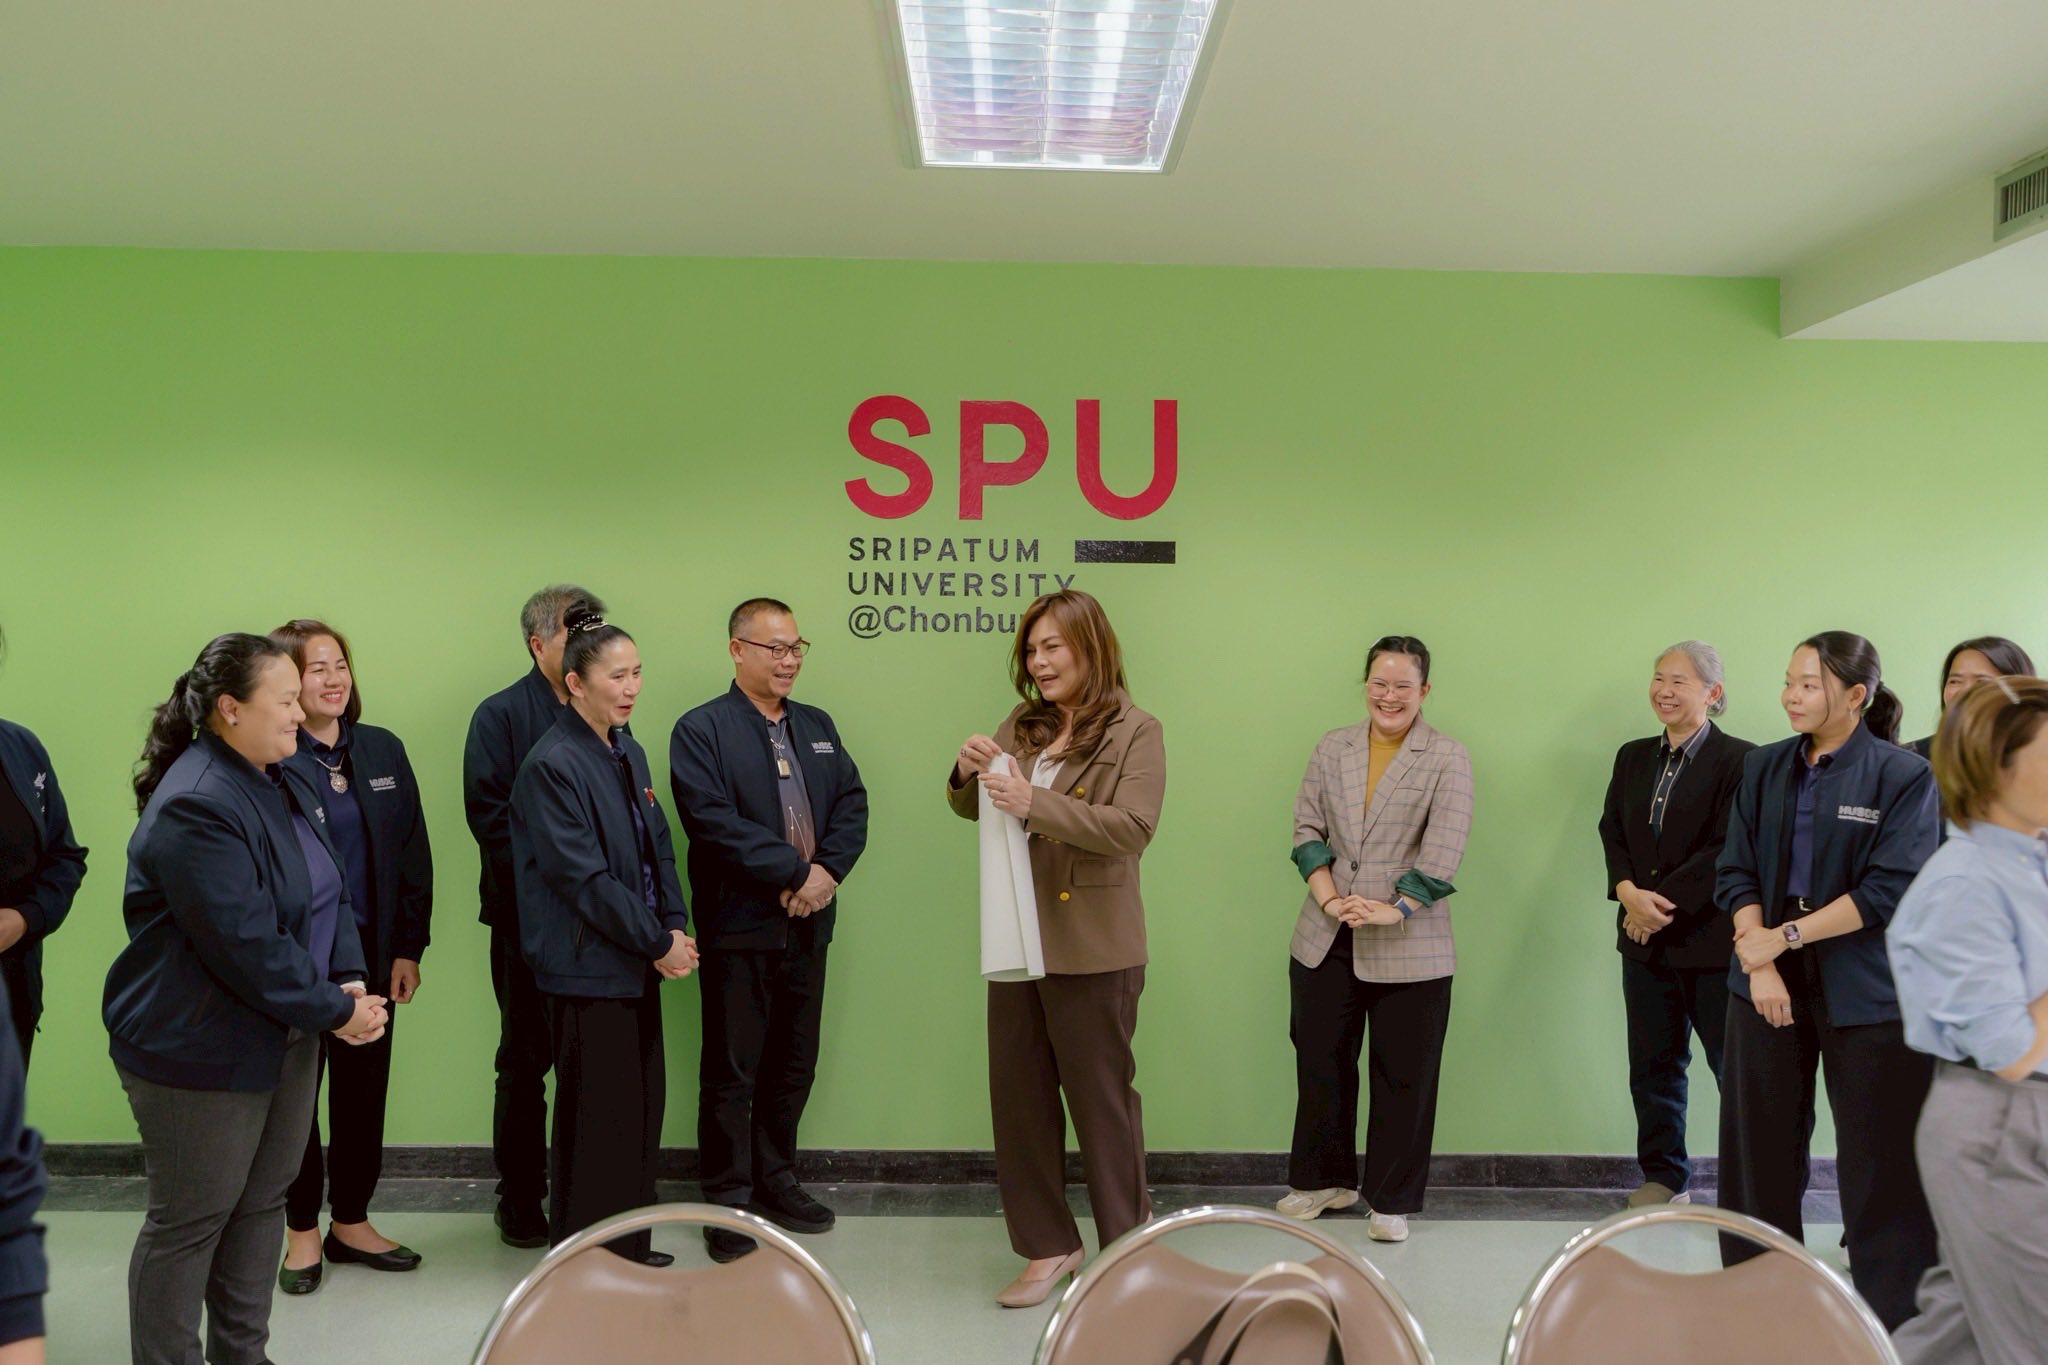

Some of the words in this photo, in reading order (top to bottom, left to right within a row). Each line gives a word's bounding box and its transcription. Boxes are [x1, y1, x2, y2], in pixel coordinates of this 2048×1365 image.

[845, 395, 1178, 521] SPU
[848, 537, 1040, 563] SRIPATUM
[848, 571, 1077, 597] UNIVERSITY
[848, 604, 1025, 639] @Chonbu
